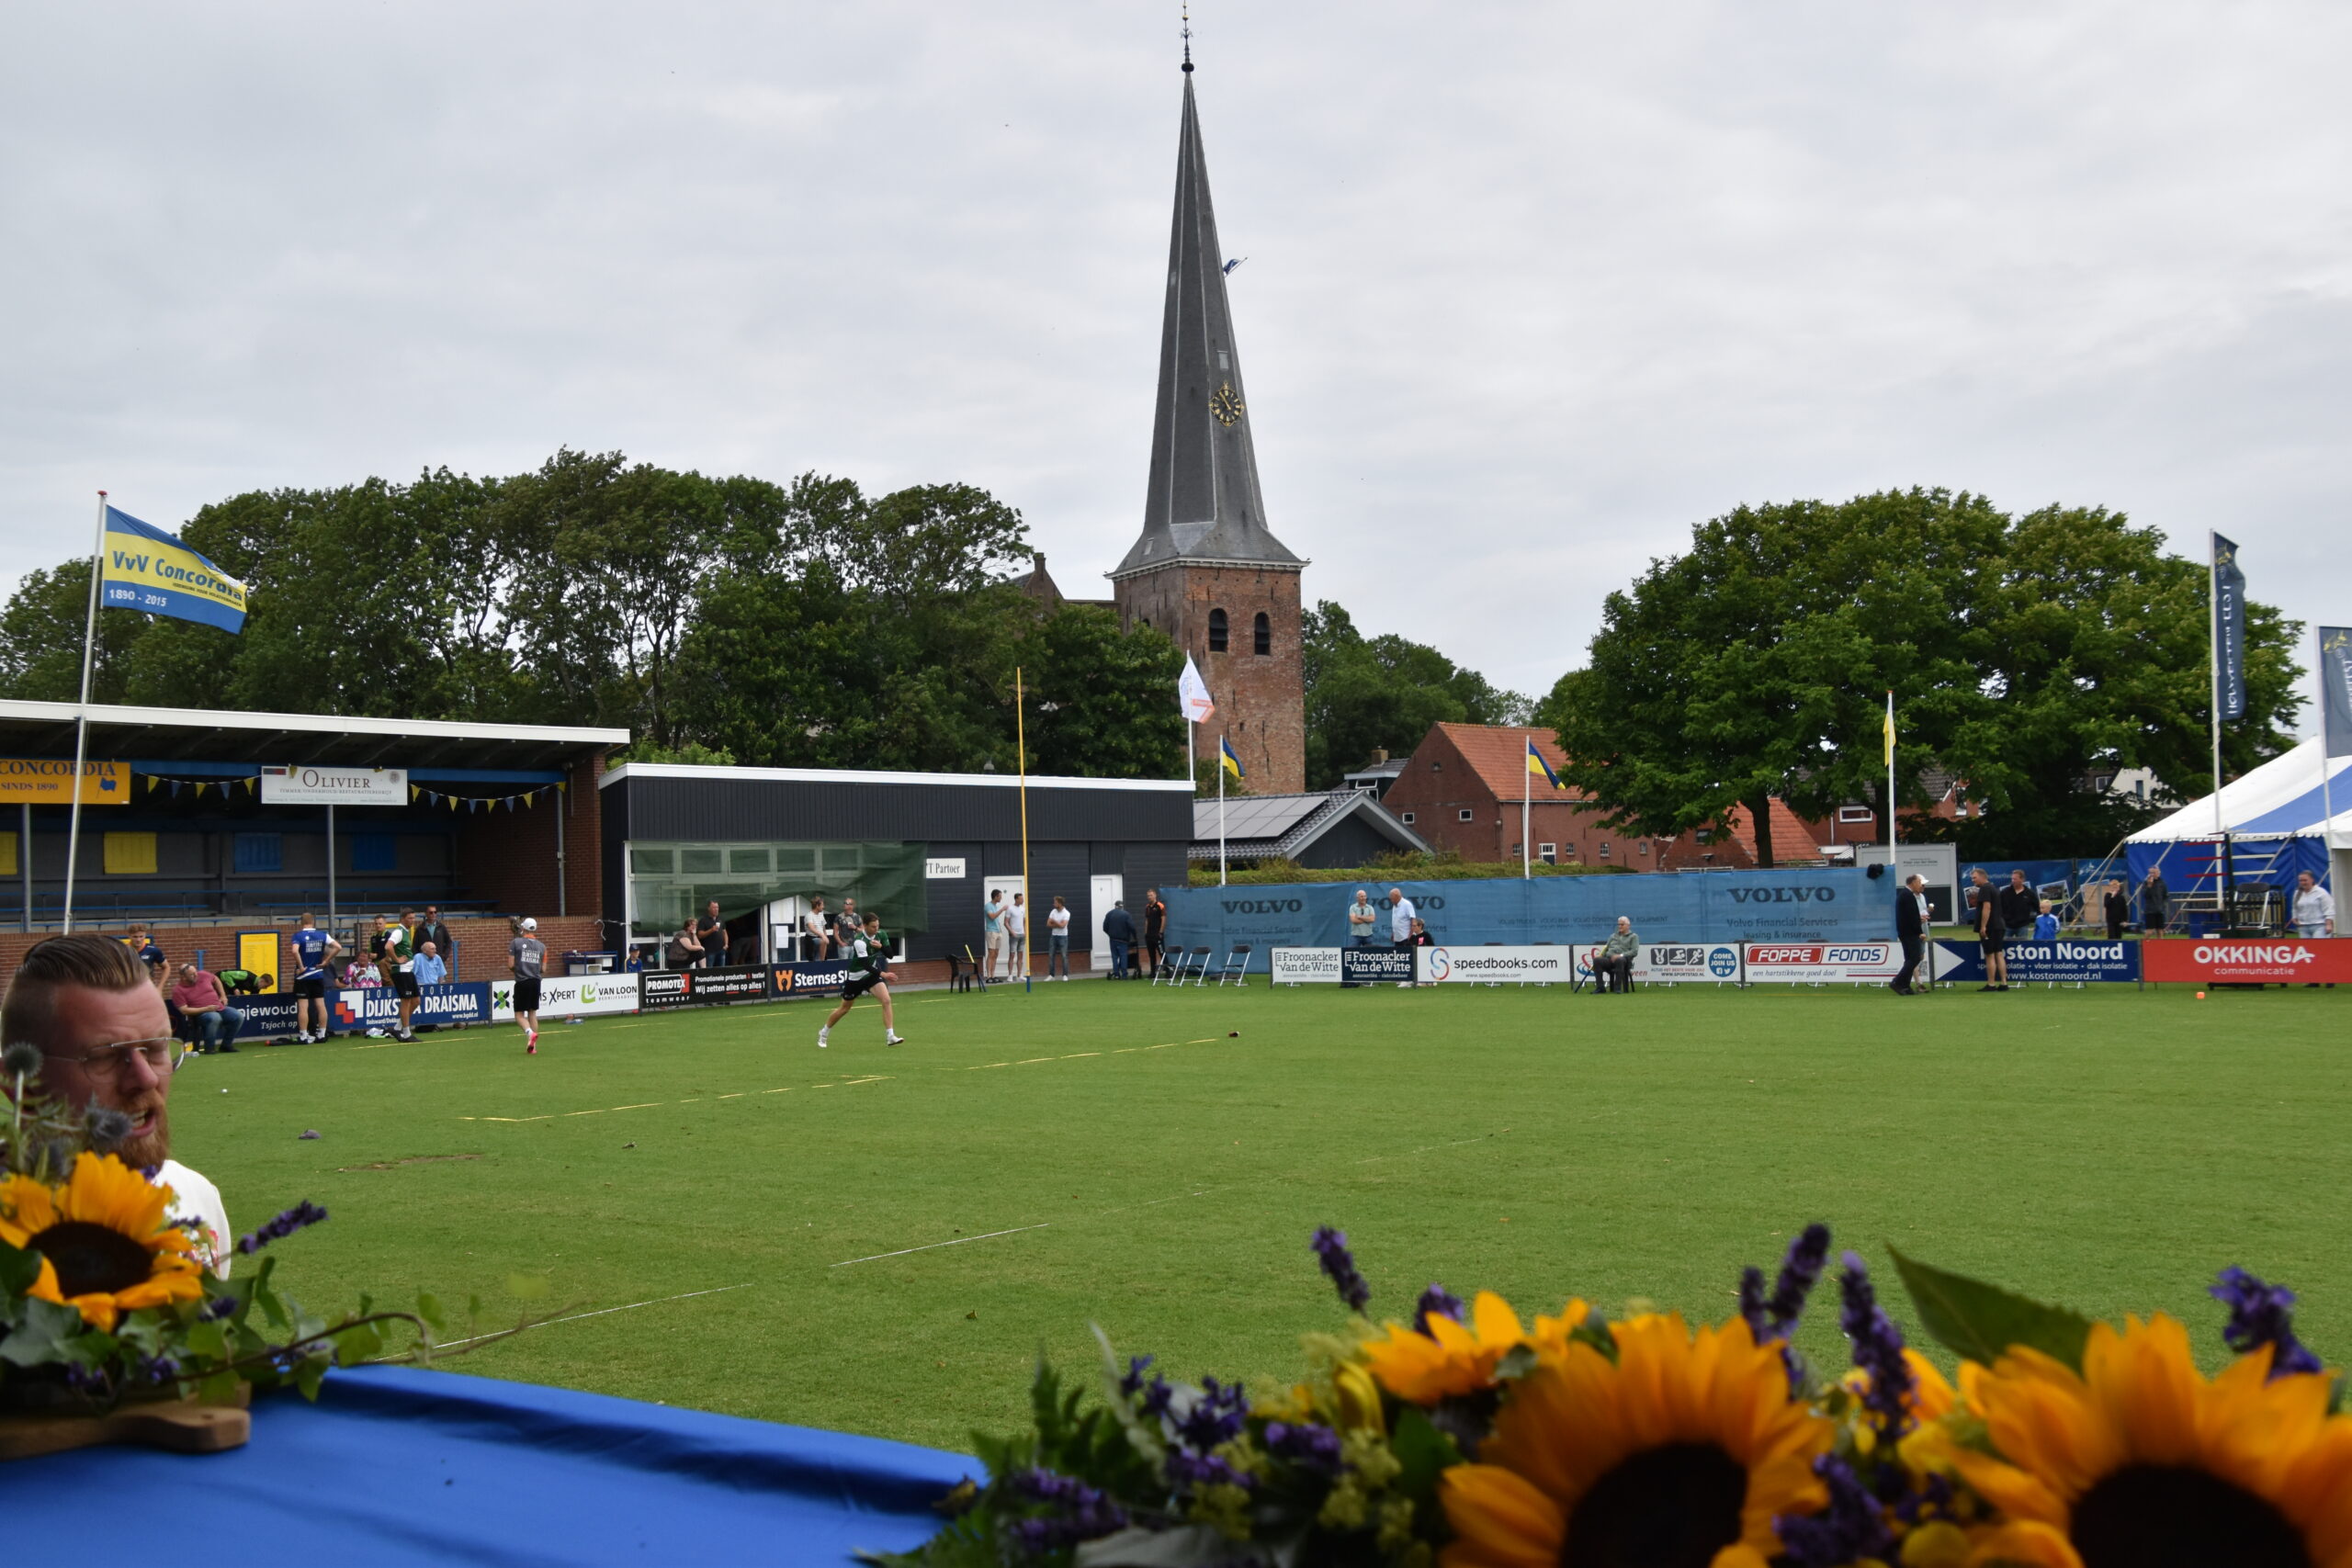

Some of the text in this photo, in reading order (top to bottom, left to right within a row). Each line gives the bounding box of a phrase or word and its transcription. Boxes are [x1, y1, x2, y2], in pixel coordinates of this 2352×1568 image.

[113, 551, 149, 572] VvV
[108, 589, 135, 601] 1890
[145, 594, 167, 607] 2015
[1, 783, 59, 791] SINDS 1890
[935, 863, 960, 874] Partoer
[1727, 886, 1835, 903] VOLVO
[1221, 899, 1302, 914] VOLVO
[1365, 896, 1445, 910] VOVO
[1727, 917, 1838, 928] Volvo Financial Services
[1744, 930, 1821, 941] leasing & insurance
[1283, 951, 1338, 962] Froonacker
[1353, 950, 1410, 962] Froonacker
[1758, 949, 1881, 962] FOPPE FONDS
[2057, 942, 2124, 959] Noord
[2194, 946, 2315, 964] OKKINGA
[1281, 962, 1339, 972] Van de Witte
[1350, 962, 1410, 972] Van de Witte
[1453, 957, 1558, 970] speedbooks.com
[1806, 969, 1821, 979] goed
[2214, 966, 2294, 975] communicatie
[647, 978, 685, 990] PROMOTEX
[795, 972, 837, 987] Sternse
[367, 987, 453, 999] BOUROEP
[616, 986, 637, 994] LOON
[695, 985, 706, 994] Wij
[726, 982, 739, 991] alles
[749, 981, 761, 989] alles
[367, 994, 478, 1018] DIJKSA DRAISMA
[261, 1021, 286, 1031] Tsjoch
